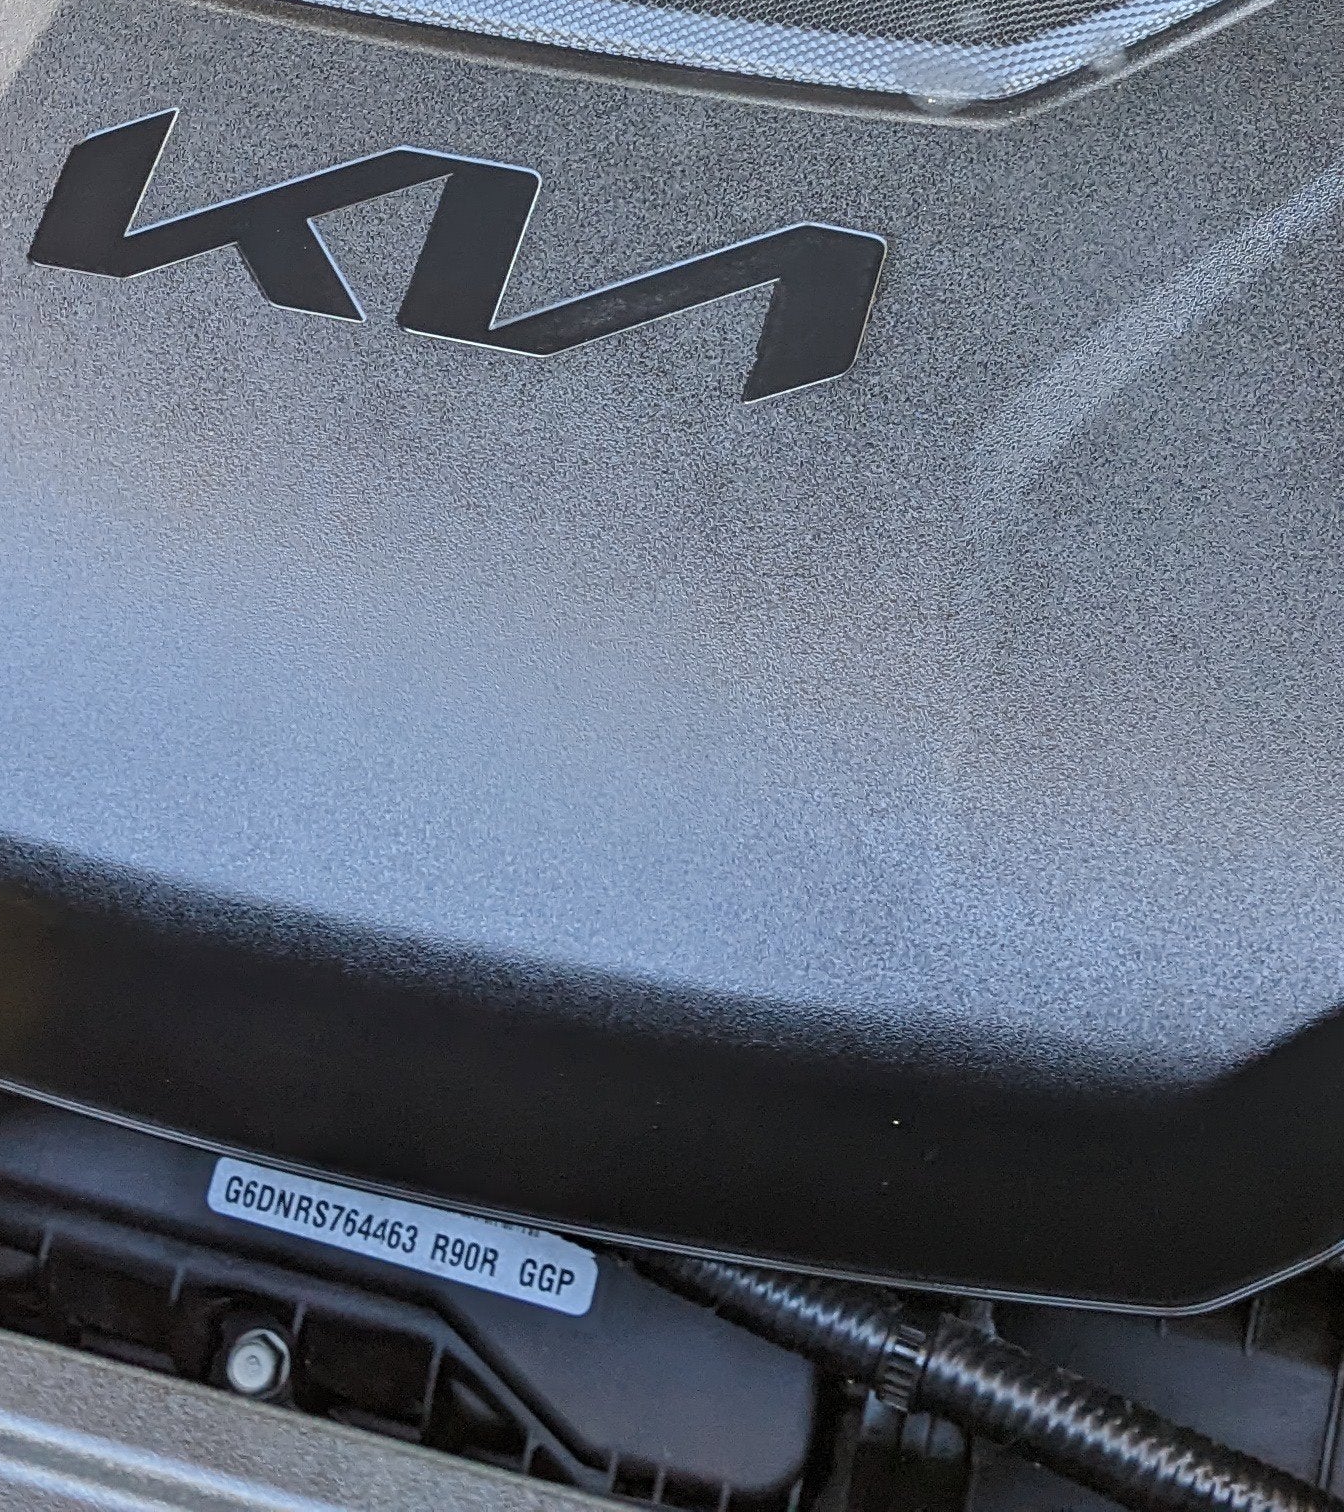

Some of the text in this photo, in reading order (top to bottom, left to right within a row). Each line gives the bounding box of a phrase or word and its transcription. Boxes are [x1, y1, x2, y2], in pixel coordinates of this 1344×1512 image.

[28, 107, 888, 404] KIA
[225, 1174, 576, 1296] G6DNRS764463 R90R GGP
